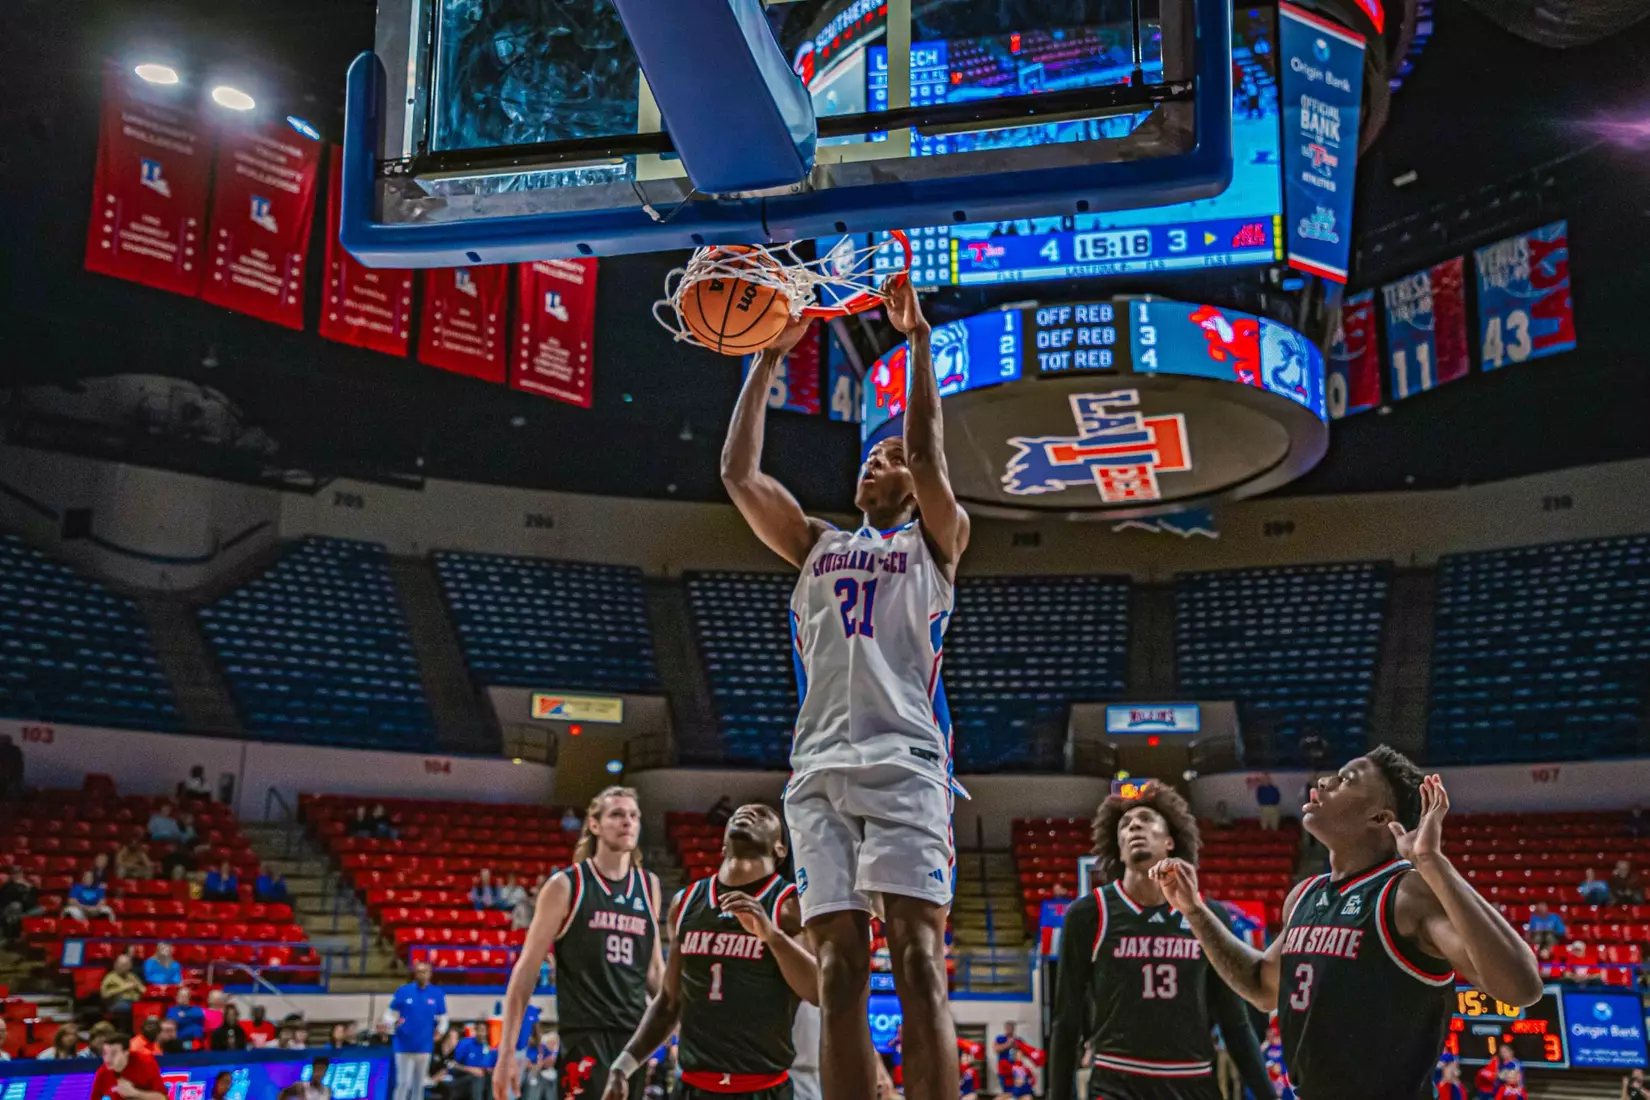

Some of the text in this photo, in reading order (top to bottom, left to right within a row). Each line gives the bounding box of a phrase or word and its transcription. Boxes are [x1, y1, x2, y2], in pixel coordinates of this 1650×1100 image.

[1290, 57, 1351, 92] Origin Bank
[1301, 109, 1341, 142] BANK
[1039, 239, 1060, 262] 4
[1079, 234, 1149, 260] 15:18
[1167, 229, 1187, 252] 3
[1003, 303, 1149, 331] 1 OFF REB 1
[1000, 325, 1156, 354] 2 DEF REB 3
[1482, 309, 1532, 368] 43
[1000, 348, 1158, 376] 3 TOT REB 4
[1392, 341, 1432, 399] 11
[812, 550, 875, 577] LOUISIANA
[834, 577, 878, 639] 21
[21, 726, 54, 744] 103
[588, 911, 648, 936] JAX STATE
[606, 934, 635, 966] 99
[680, 931, 765, 959] JAX STATE
[1113, 936, 1201, 960] JAX STATE
[1304, 926, 1365, 959] STATE
[709, 962, 723, 1001] 1
[1141, 964, 1178, 999] 13
[1290, 962, 1314, 1012] 3
[1543, 1033, 1561, 1061] 3
[1571, 1023, 1640, 1039] Origin Bank
